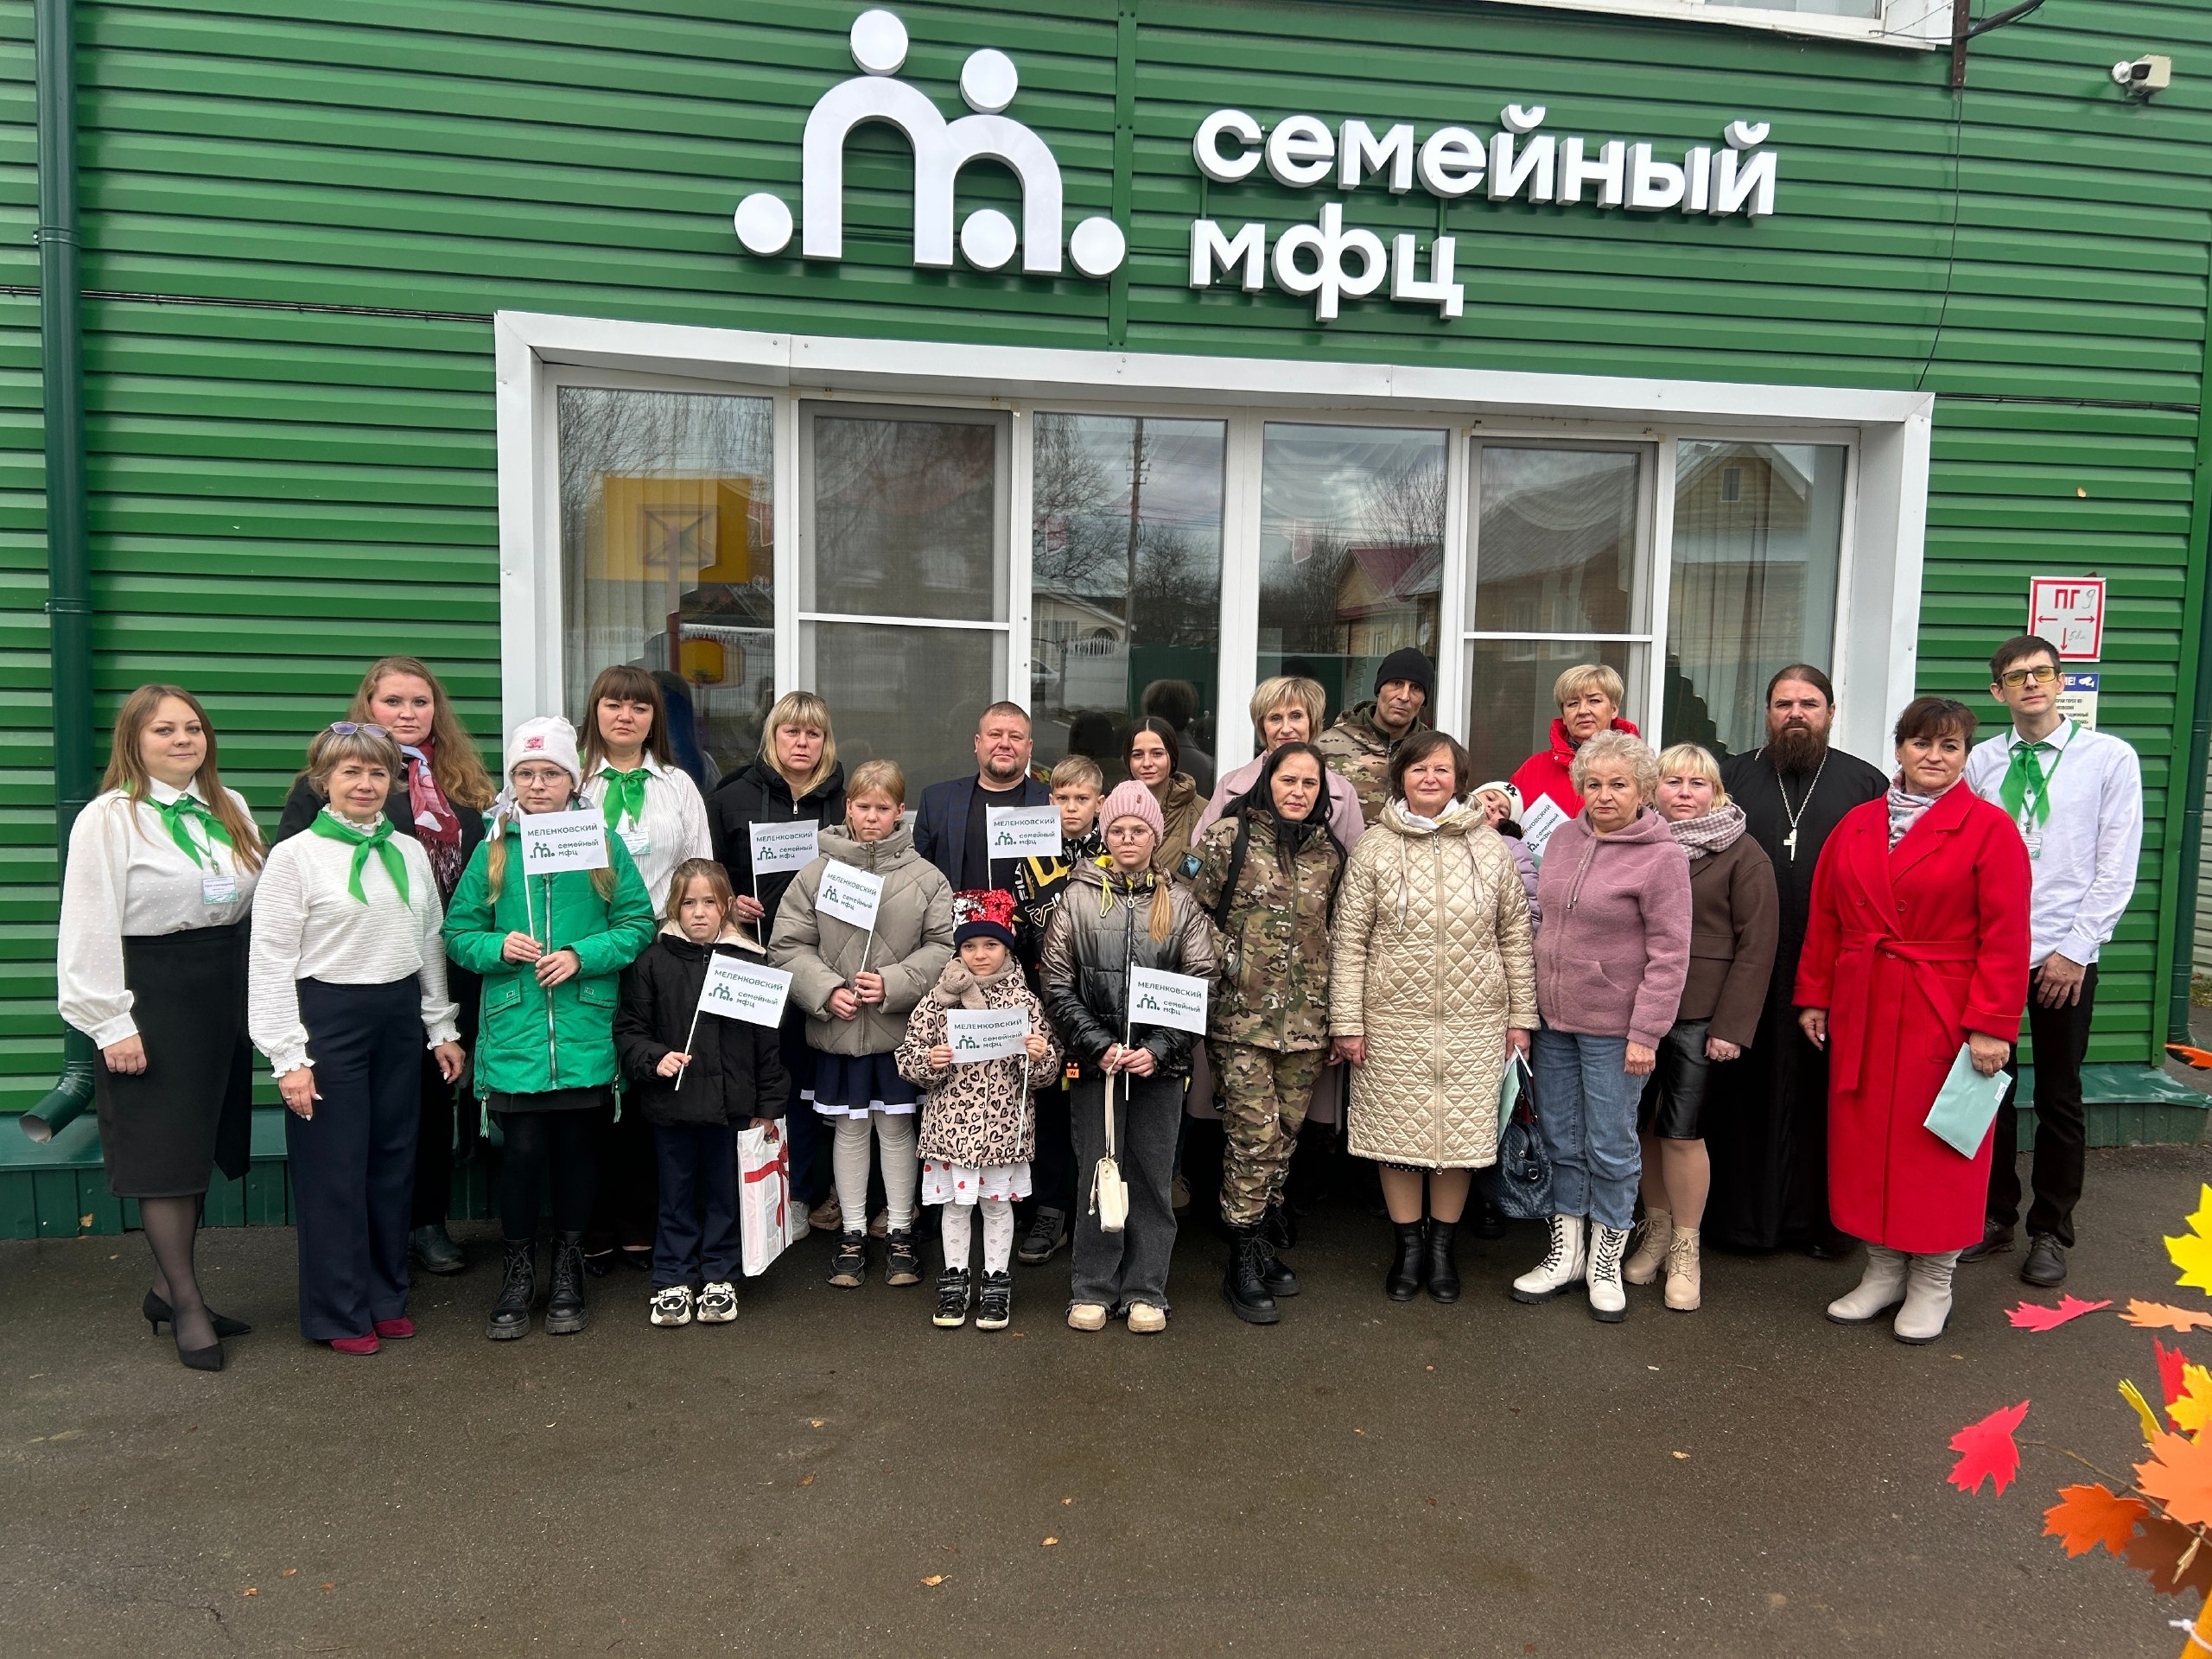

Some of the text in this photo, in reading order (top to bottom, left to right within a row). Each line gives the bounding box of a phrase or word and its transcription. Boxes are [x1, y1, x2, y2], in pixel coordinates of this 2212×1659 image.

[1192, 103, 1777, 219] семейный
[1190, 202, 1465, 322] мфц
[2054, 588, 2081, 609] ПГ
[994, 817, 1055, 827] МЕЛЕНКОВСКИЙ
[527, 823, 598, 836] МЕЛЕНКОВСКИЙ
[756, 831, 813, 842] МЕЛЕНКОВСКИЙ
[557, 840, 599, 849] семейный
[826, 873, 877, 896] МЕЛЕНКОВСКИЙ
[714, 969, 783, 991] МЕЛЕНКОВСКИЙ
[1138, 981, 1202, 999] МЕЛЕНКОВСКИЙ
[736, 998, 754, 1007] мфц
[738, 991, 778, 1005] семейный
[1163, 1000, 1200, 1013] семейный
[954, 1019, 1022, 1030] МЕЛЕНКОВСКИЙ
[983, 1032, 1022, 1041] семейный
